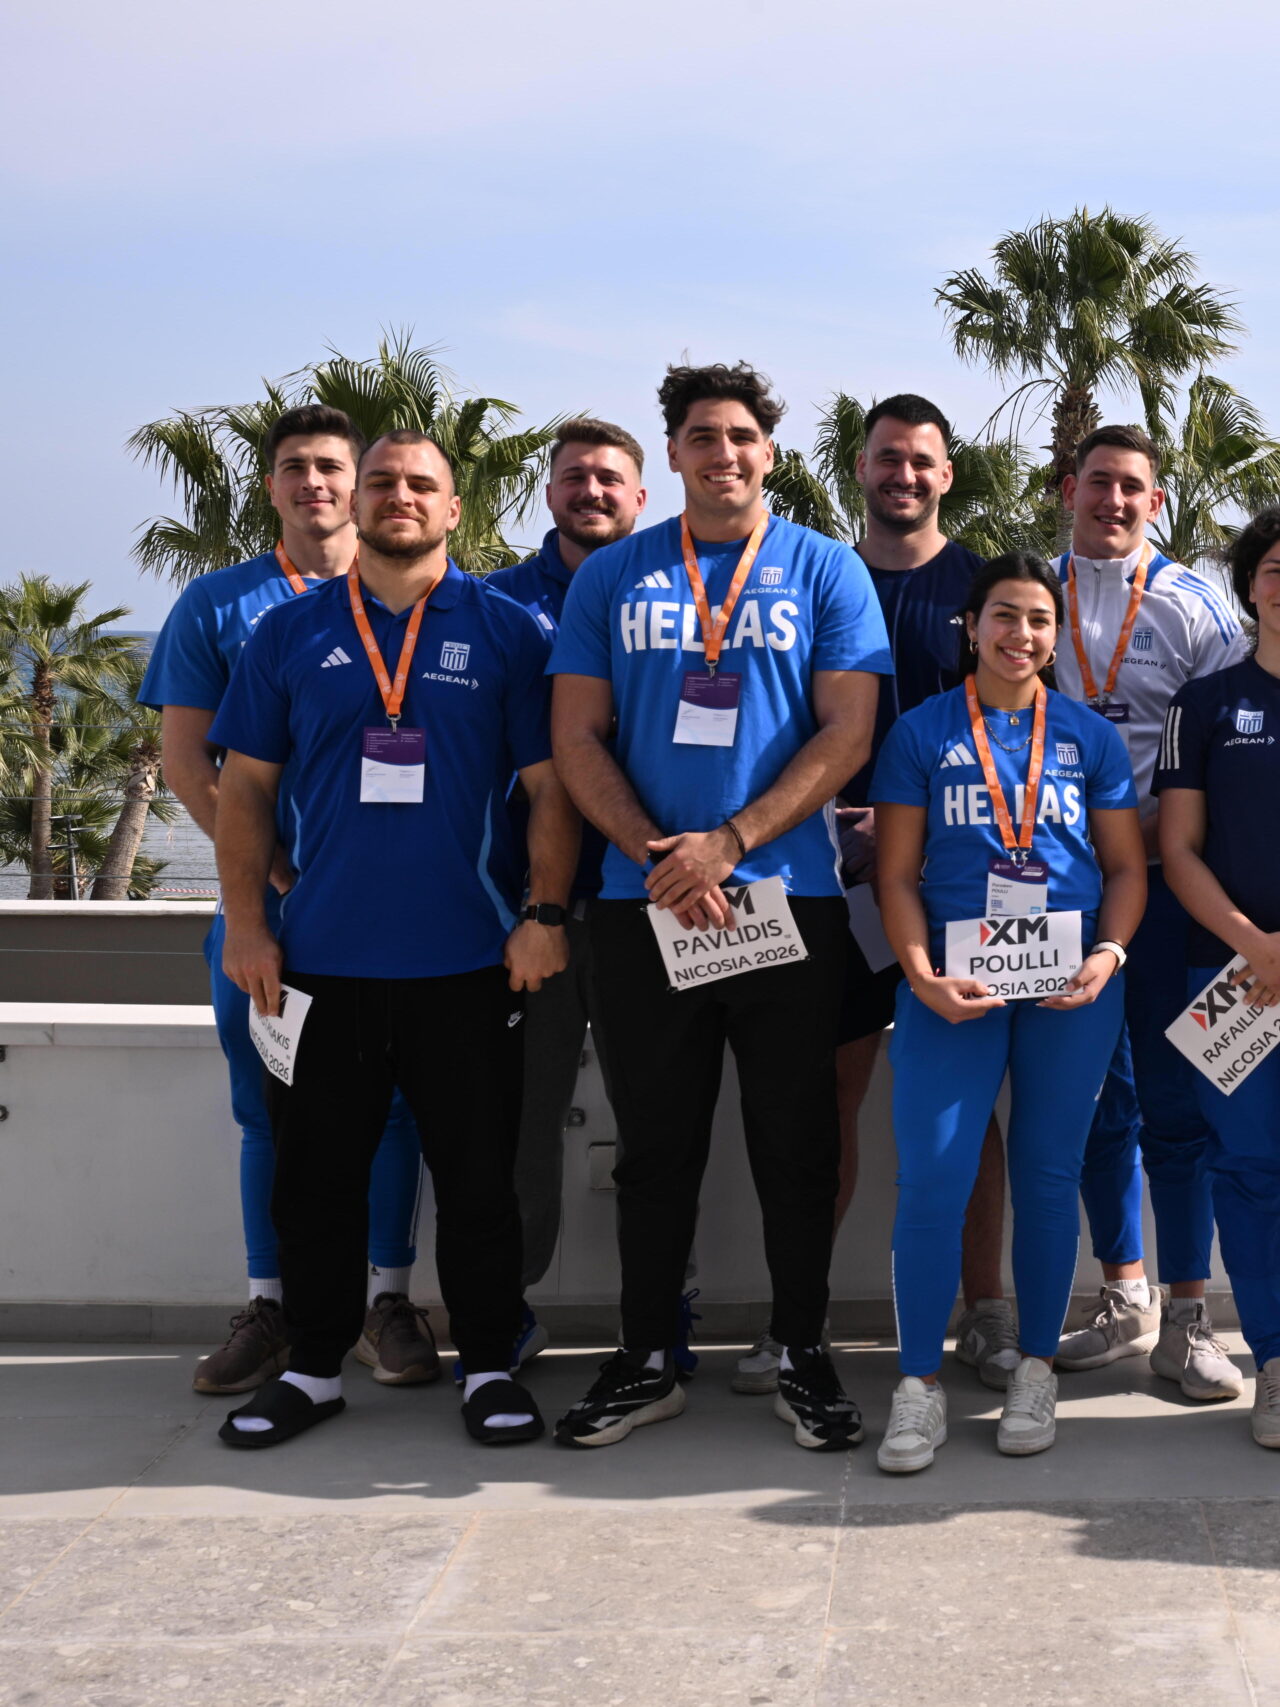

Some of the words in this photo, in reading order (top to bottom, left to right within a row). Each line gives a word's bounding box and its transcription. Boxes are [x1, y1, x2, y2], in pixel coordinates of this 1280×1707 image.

[422, 672, 469, 686] AEGEAN
[1224, 737, 1265, 747] AEGEAN
[672, 919, 783, 958] PAVLIDIS
[986, 916, 1049, 946] XM
[674, 955, 752, 983] NICOSIA
[754, 944, 800, 965] 2026
[969, 949, 1059, 975] POULLI
[962, 981, 1030, 1000] OSIA
[1034, 977, 1068, 993] 202
[1202, 1000, 1269, 1064] RAFAILID
[268, 1054, 290, 1081] 2026
[1217, 1030, 1278, 1088] NICOSIA
